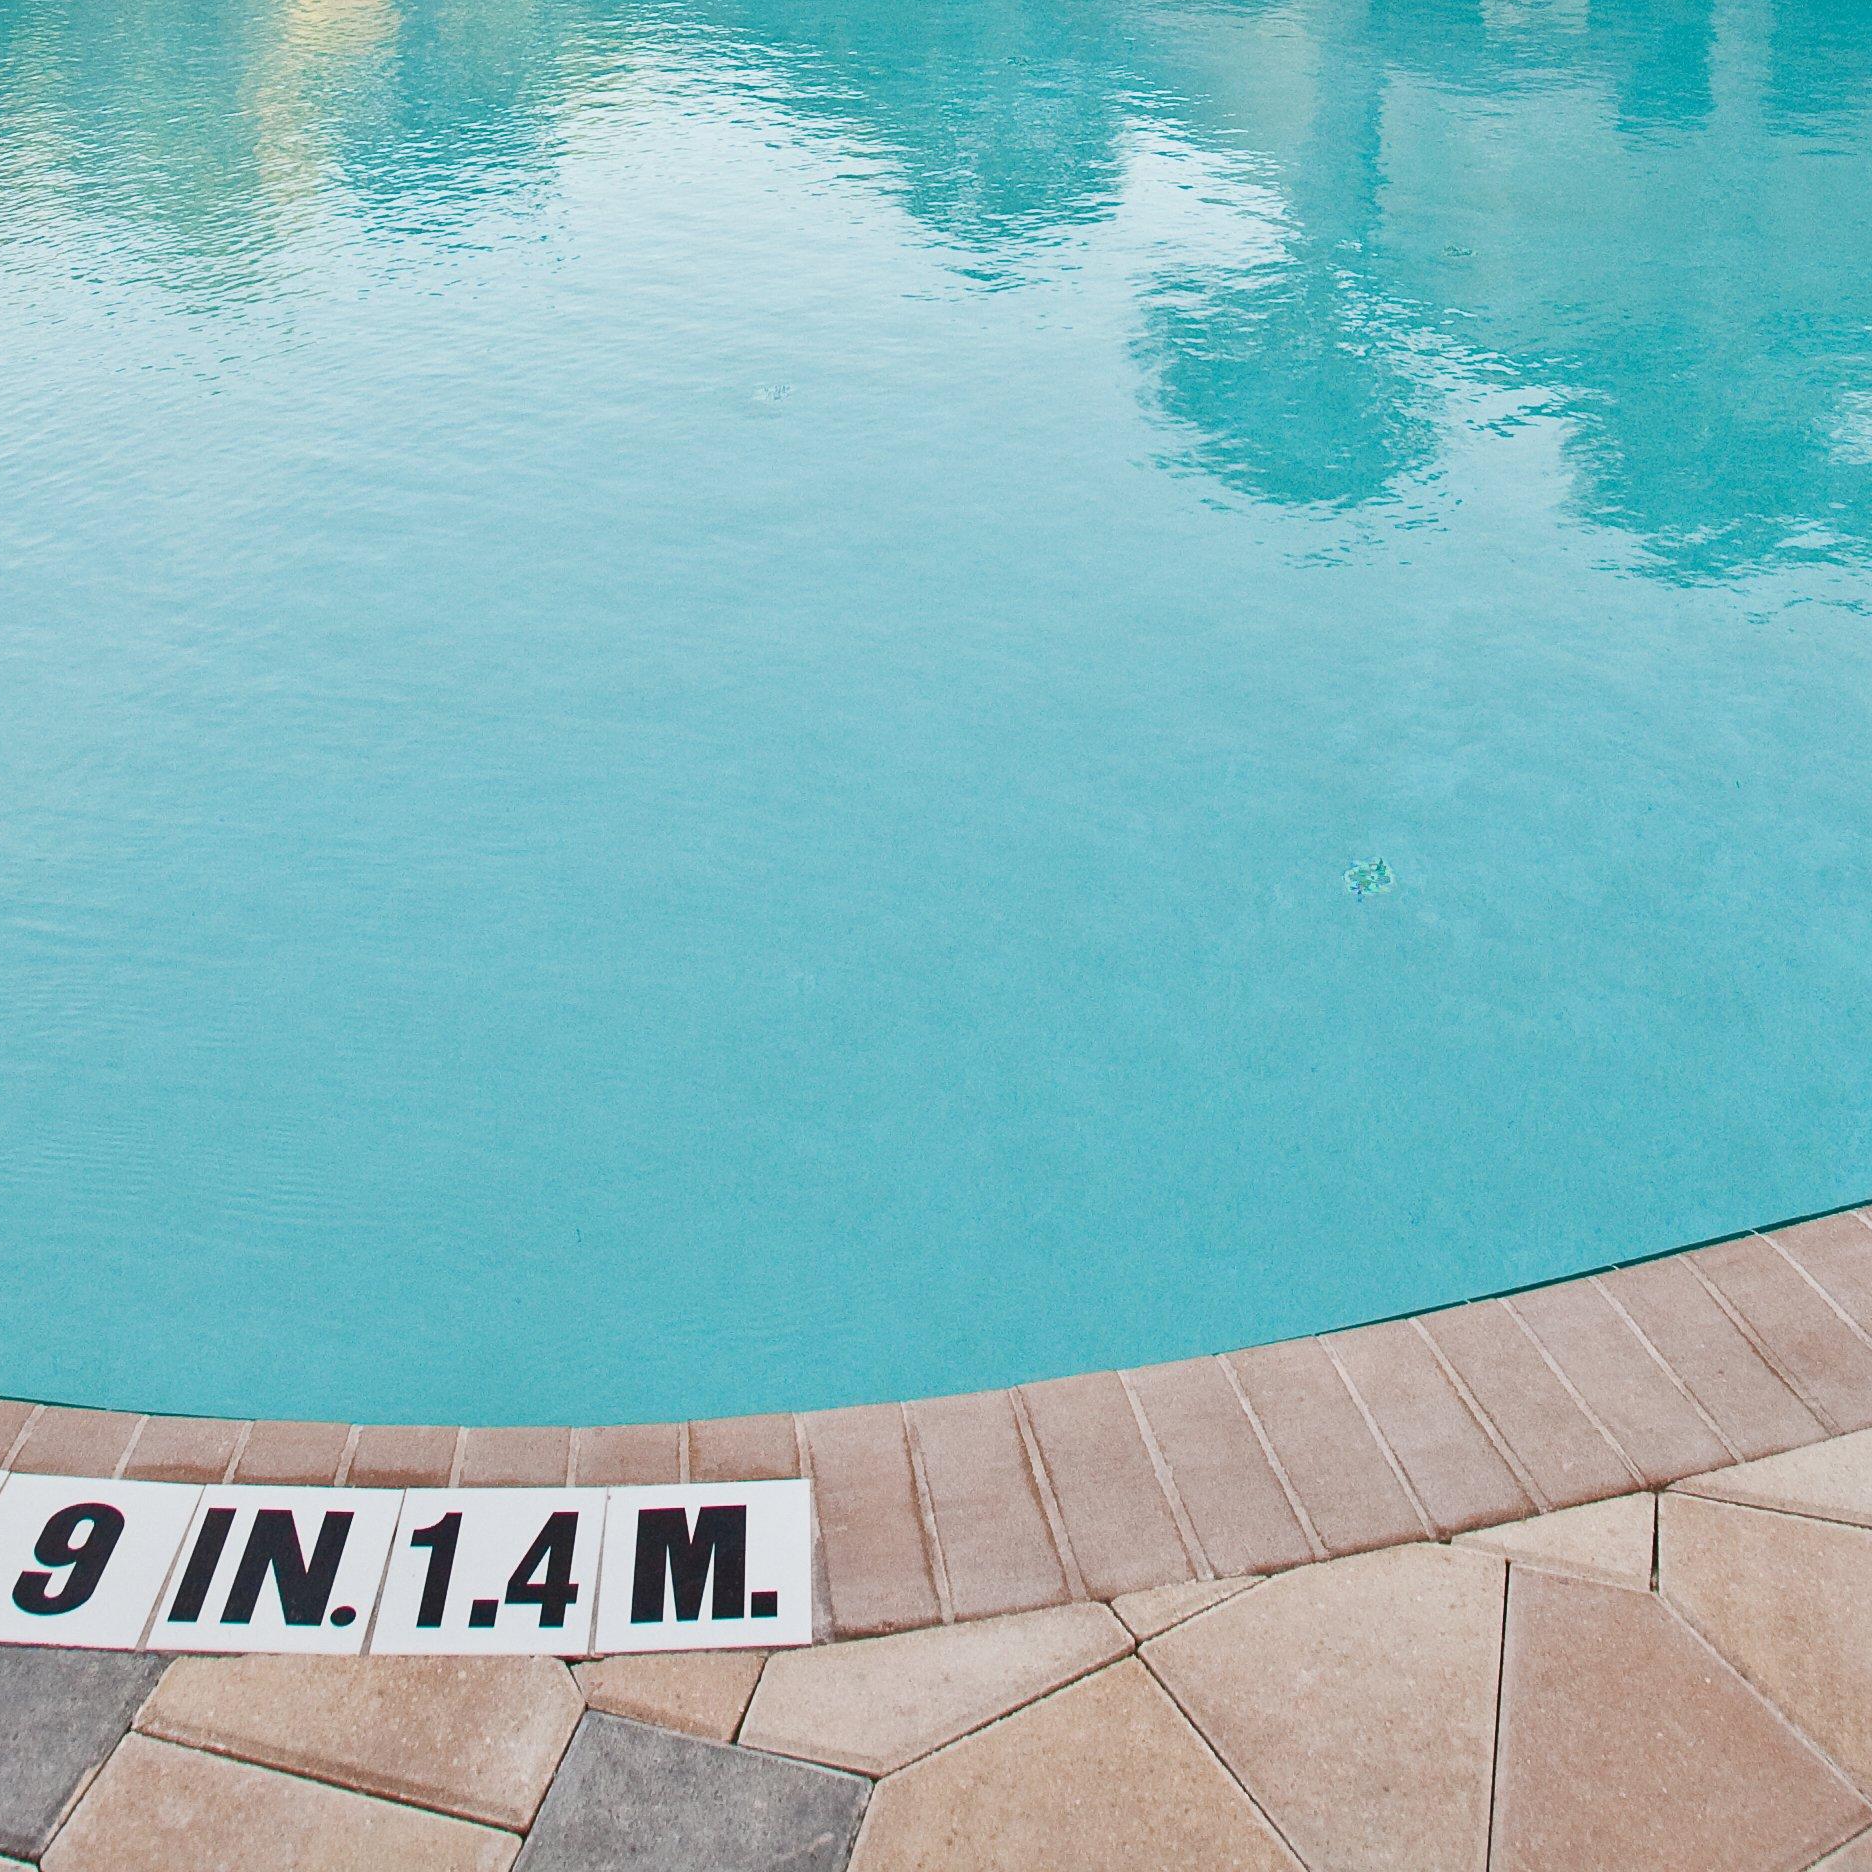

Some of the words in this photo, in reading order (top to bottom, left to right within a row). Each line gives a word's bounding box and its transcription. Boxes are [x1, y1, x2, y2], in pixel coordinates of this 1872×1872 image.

[11, 1502, 126, 1616] 9
[166, 1507, 357, 1627] IN.
[409, 1511, 580, 1628] 1.4
[630, 1504, 779, 1624] M.
